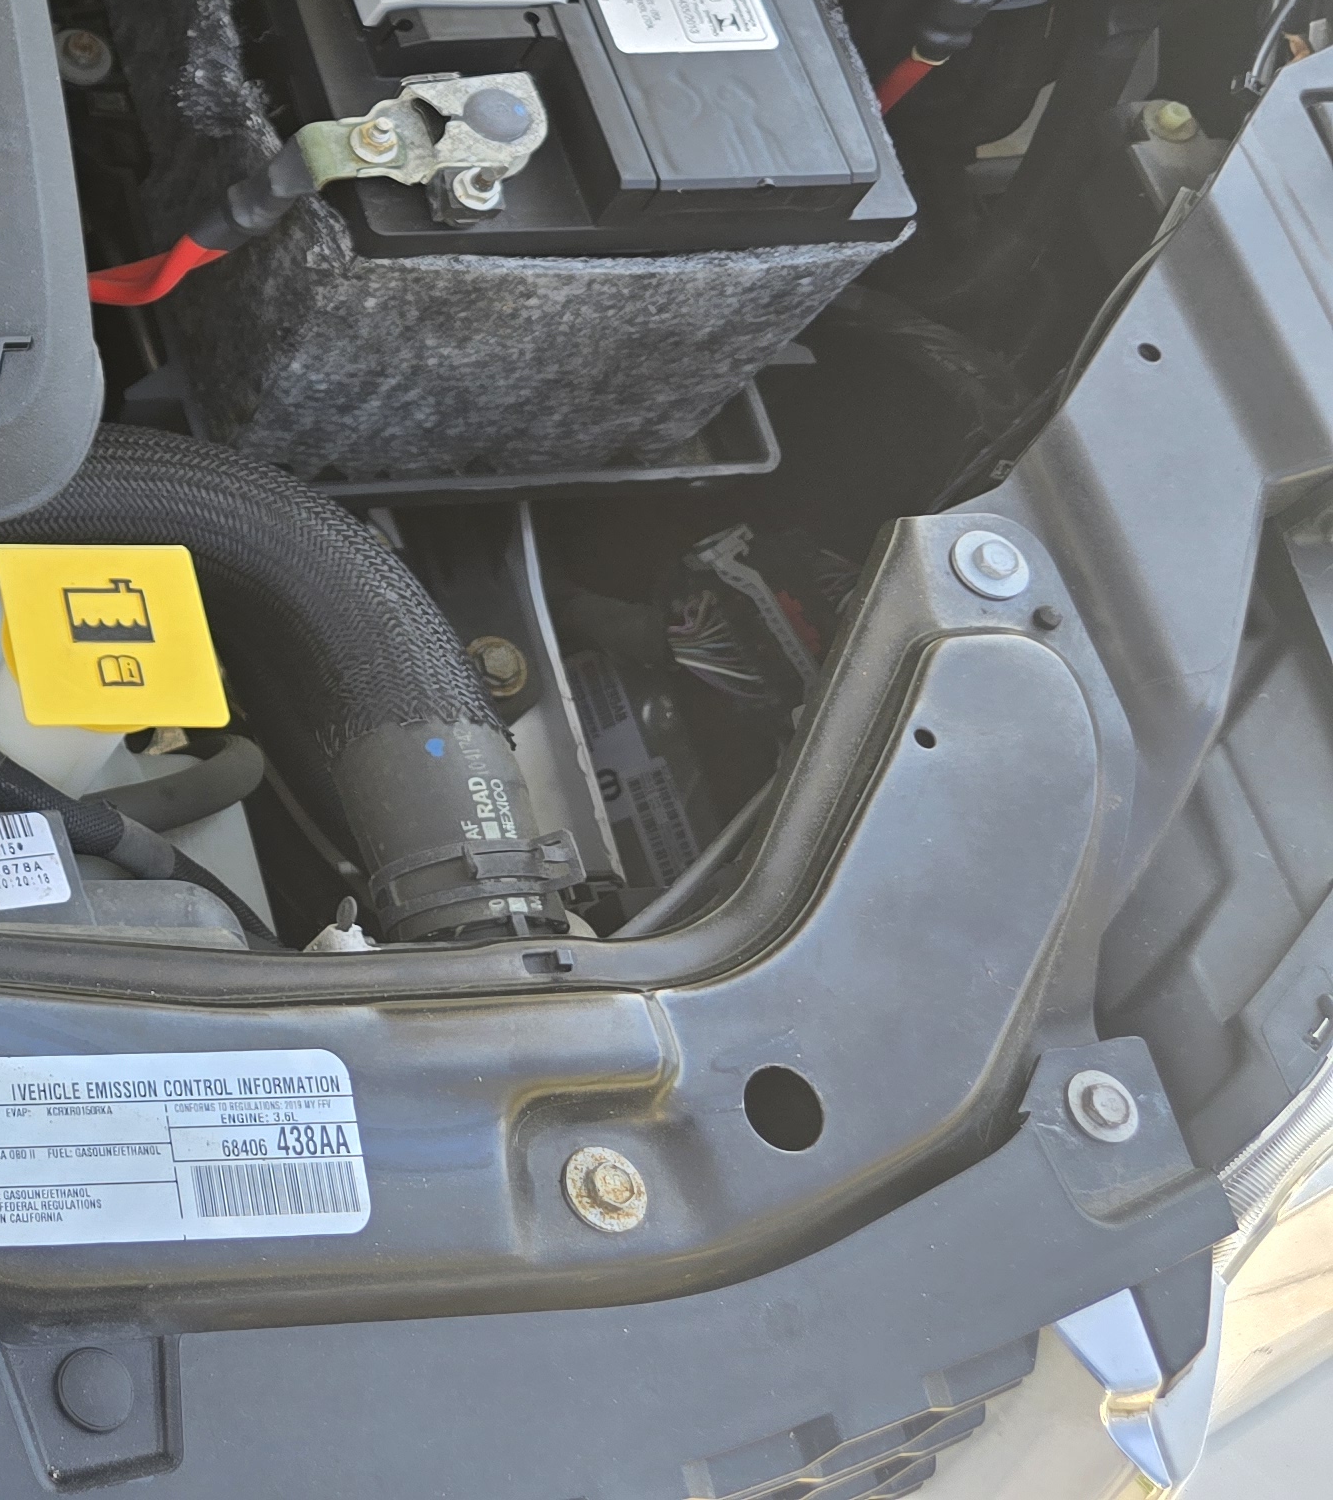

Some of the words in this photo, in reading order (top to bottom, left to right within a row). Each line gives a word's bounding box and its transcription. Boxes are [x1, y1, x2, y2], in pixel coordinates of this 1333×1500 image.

[468, 777, 495, 818] RAD
[490, 778, 518, 839] MEXICO
[86, 1079, 158, 1100] EMISSION
[163, 1078, 233, 1097] CONTROL
[237, 1075, 341, 1095] INFORMATION
[6, 1108, 32, 1117] EVAP:
[221, 1113, 269, 1124] ENGINE:
[273, 1112, 299, 1123] 3.6L
[222, 1138, 269, 1158] 68406
[276, 1124, 351, 1156] 438AA
[47, 1148, 73, 1159] FUEL:
[75, 1145, 161, 1158] GASOLINE/ETHANOL
[3, 1188, 91, 1200] GASOLINE/ETHANOL
[0, 1200, 39, 1212] FEDERAL
[41, 1199, 102, 1211] REGULATIONS
[9, 1212, 63, 1223] CALIFORNIA
